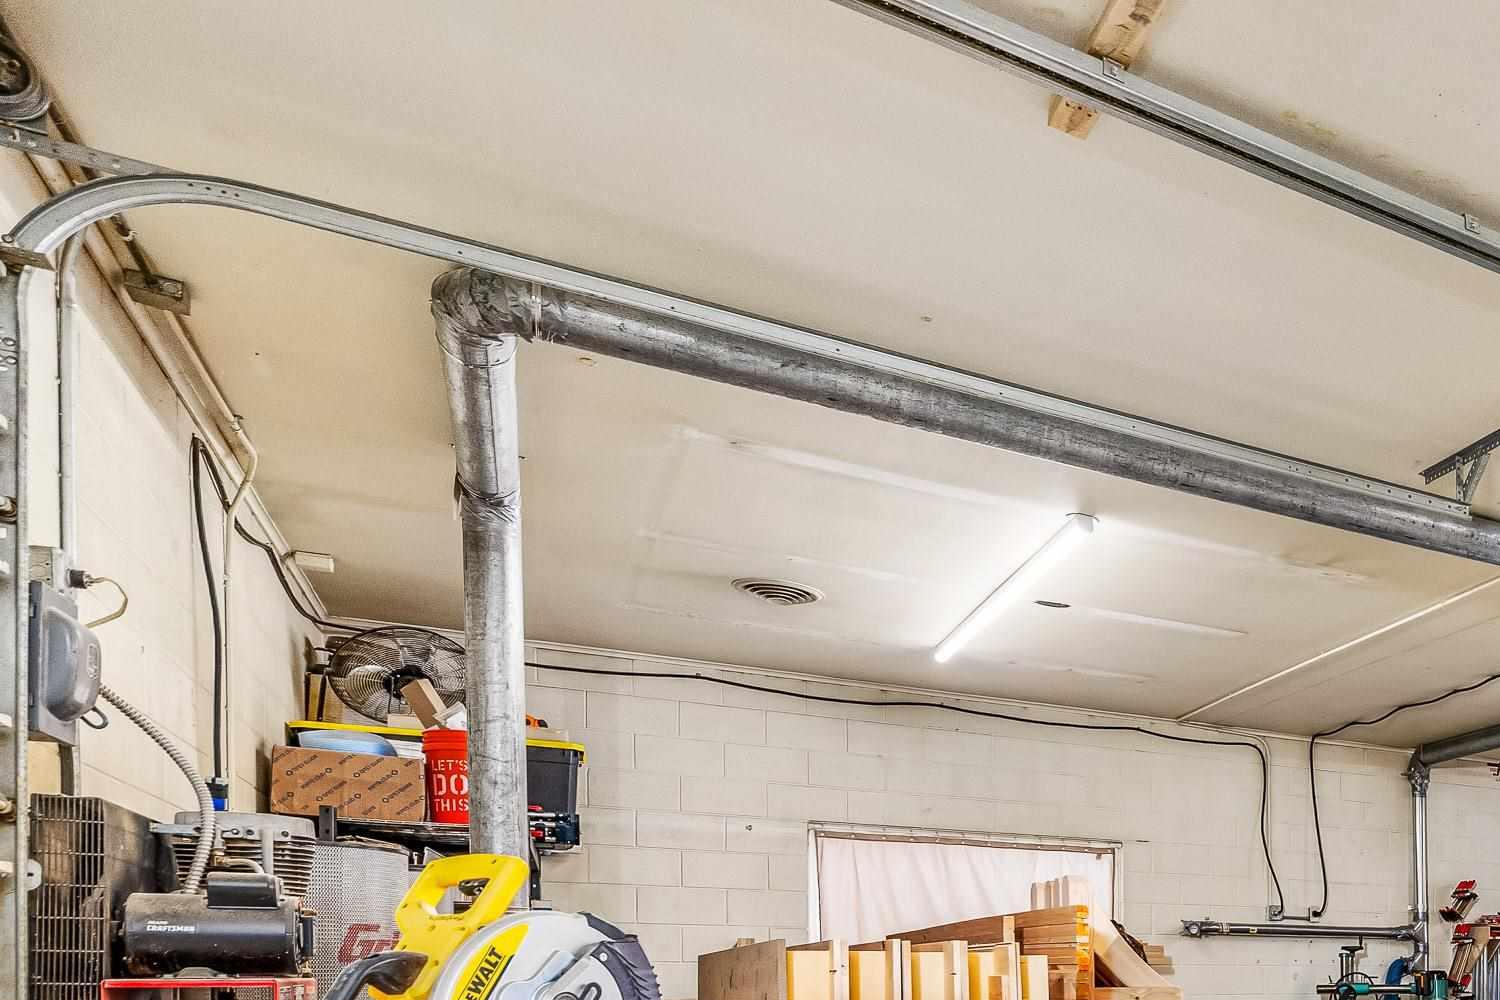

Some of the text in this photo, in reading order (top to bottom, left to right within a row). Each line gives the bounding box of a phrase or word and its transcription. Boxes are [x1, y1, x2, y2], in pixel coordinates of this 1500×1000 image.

[431, 759, 469, 771] LET'S
[432, 773, 469, 796] DO
[433, 798, 469, 812] THIS
